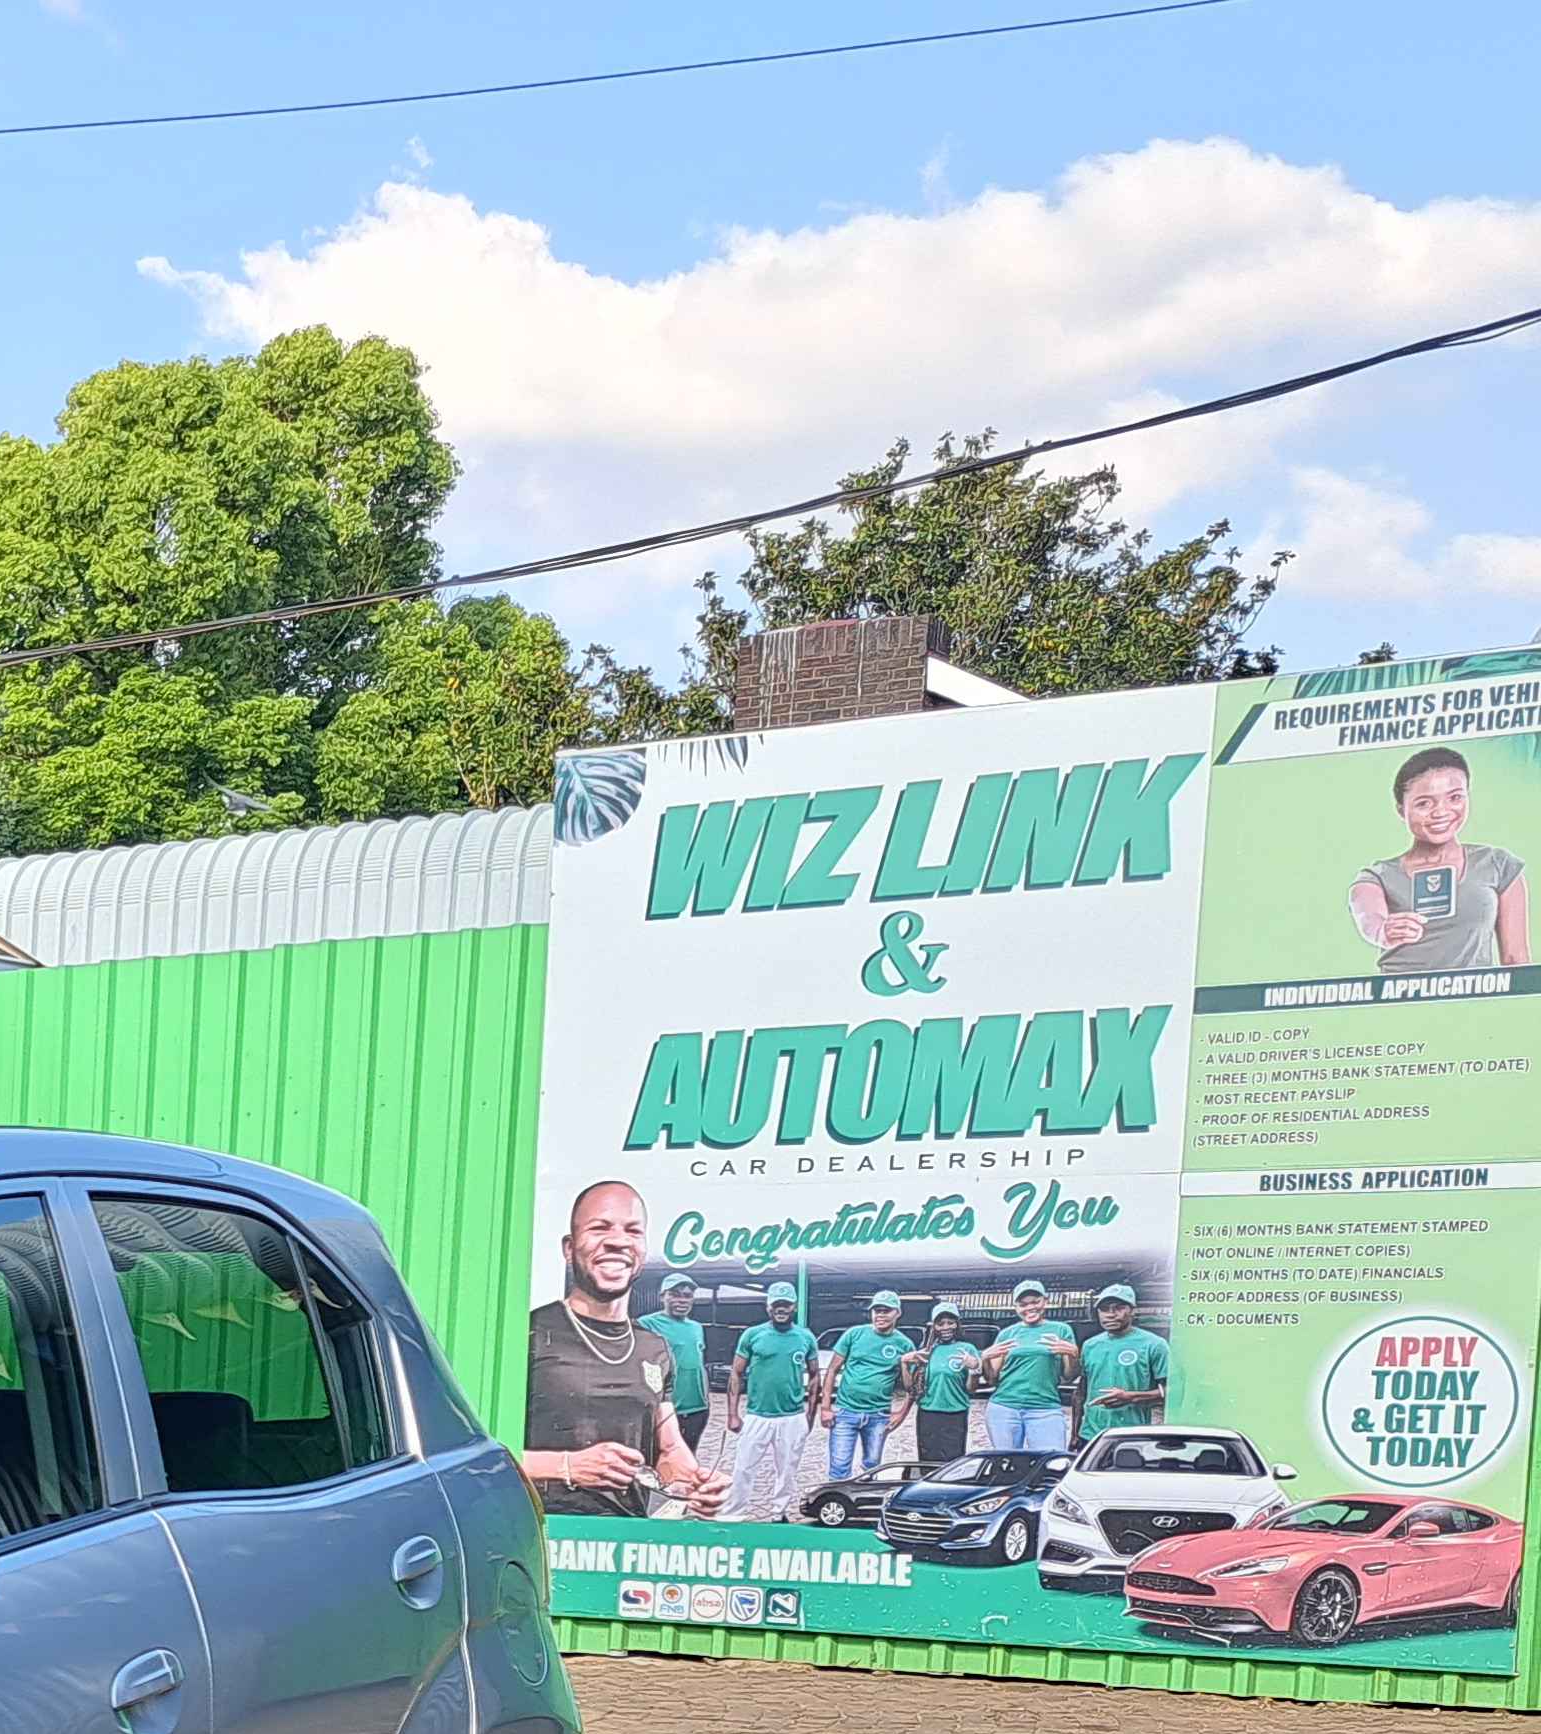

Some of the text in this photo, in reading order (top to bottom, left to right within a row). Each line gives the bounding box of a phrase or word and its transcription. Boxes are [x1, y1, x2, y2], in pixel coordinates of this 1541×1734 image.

[1274, 693, 1436, 731] REQUIREMENTS
[1442, 688, 1483, 712] FOR
[1338, 717, 1428, 747] FINANCE
[646, 752, 1206, 921] WIZ LINK
[860, 910, 950, 997] &
[1264, 972, 1512, 1007] INDIVIDUAL APPLICATION
[1208, 1027, 1310, 1045] VALID ID COPY
[1205, 1052, 1215, 1065] A
[1218, 1050, 1255, 1064] VALID
[1325, 1044, 1383, 1060] LICENSE
[1386, 1043, 1425, 1057] COPY
[623, 1004, 1173, 1152] AUTOMAX
[1204, 1088, 1356, 1106] MOST RECENT PAYSLIP
[690, 1148, 1087, 1177] CAR DEALERSHIP
[1259, 1167, 1489, 1193] BUSINESS APPLICATION
[663, 1178, 1120, 1272] Congratulates You
[1193, 1224, 1215, 1238] SIX
[1236, 1223, 1292, 1237] MONTHS
[1296, 1222, 1334, 1236] BANK
[1336, 1220, 1418, 1235] STATEMENT
[1421, 1219, 1489, 1234] STAMPED
[1187, 1312, 1299, 1326] CK DOCUMENTS
[1375, 1336, 1479, 1368] APPLY
[1371, 1370, 1480, 1401] TODAY
[1351, 1403, 1487, 1435] & GET IT
[1366, 1436, 1474, 1468] TODAY
[622, 1541, 745, 1580] FINANCE
[748, 1546, 913, 1588] AVAILABLE
